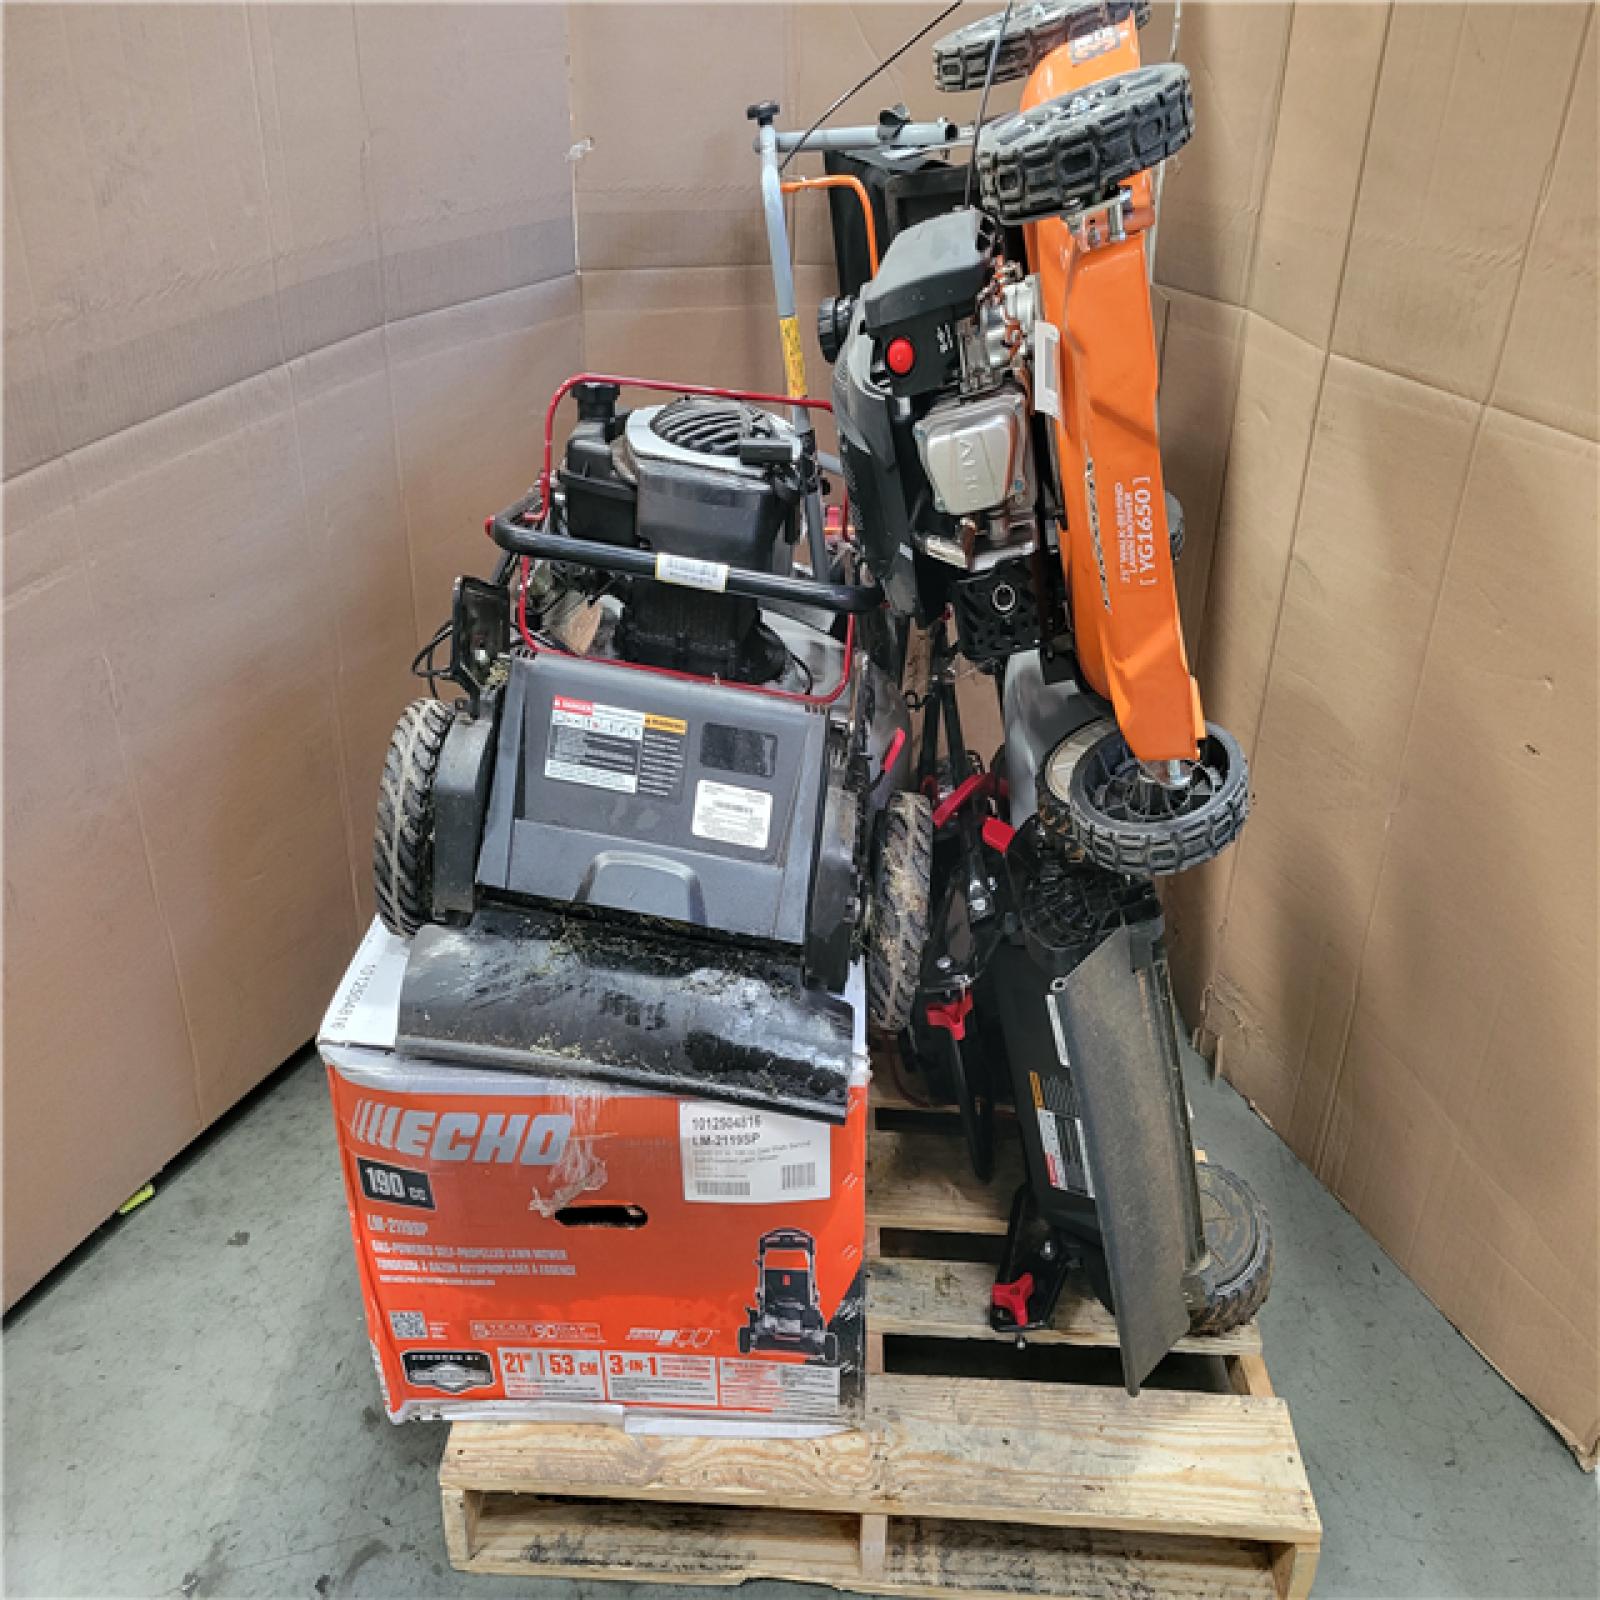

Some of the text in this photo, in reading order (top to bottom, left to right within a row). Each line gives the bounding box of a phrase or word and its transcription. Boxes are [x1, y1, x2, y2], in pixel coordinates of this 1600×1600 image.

[396, 1109, 573, 1165] ECHO
[366, 1168, 405, 1198] 190
[549, 1354, 576, 1375] 53
